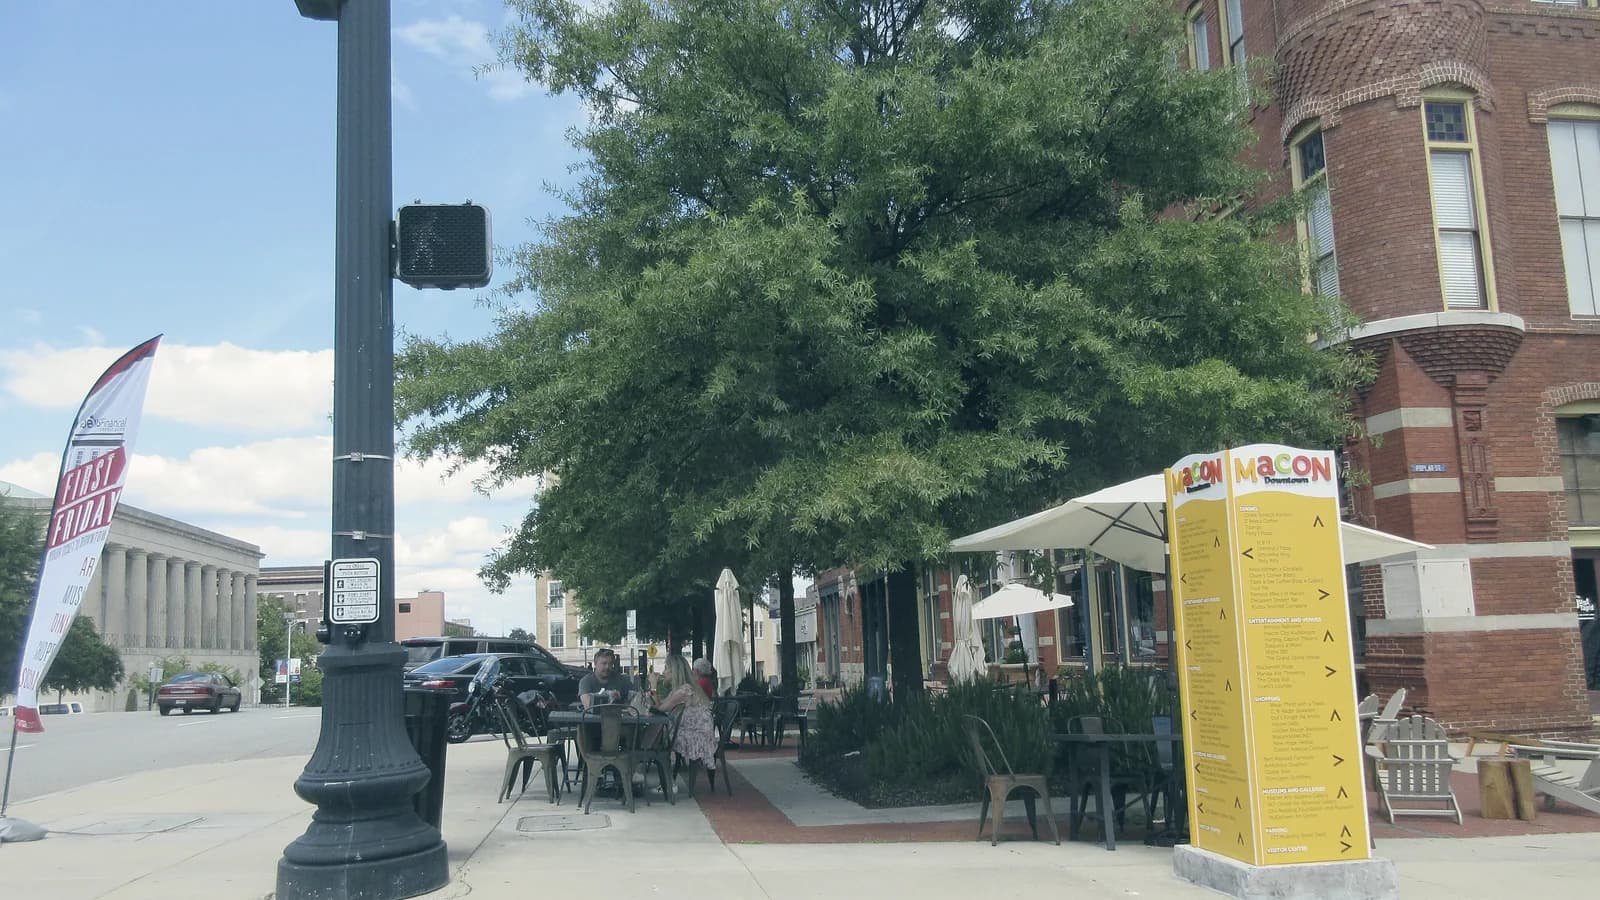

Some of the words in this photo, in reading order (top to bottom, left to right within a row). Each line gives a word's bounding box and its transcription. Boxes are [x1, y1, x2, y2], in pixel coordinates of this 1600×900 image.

[62, 452, 117, 505] FIRST
[1264, 476, 1310, 485] Downtown
[52, 489, 122, 547] FRIDAY
